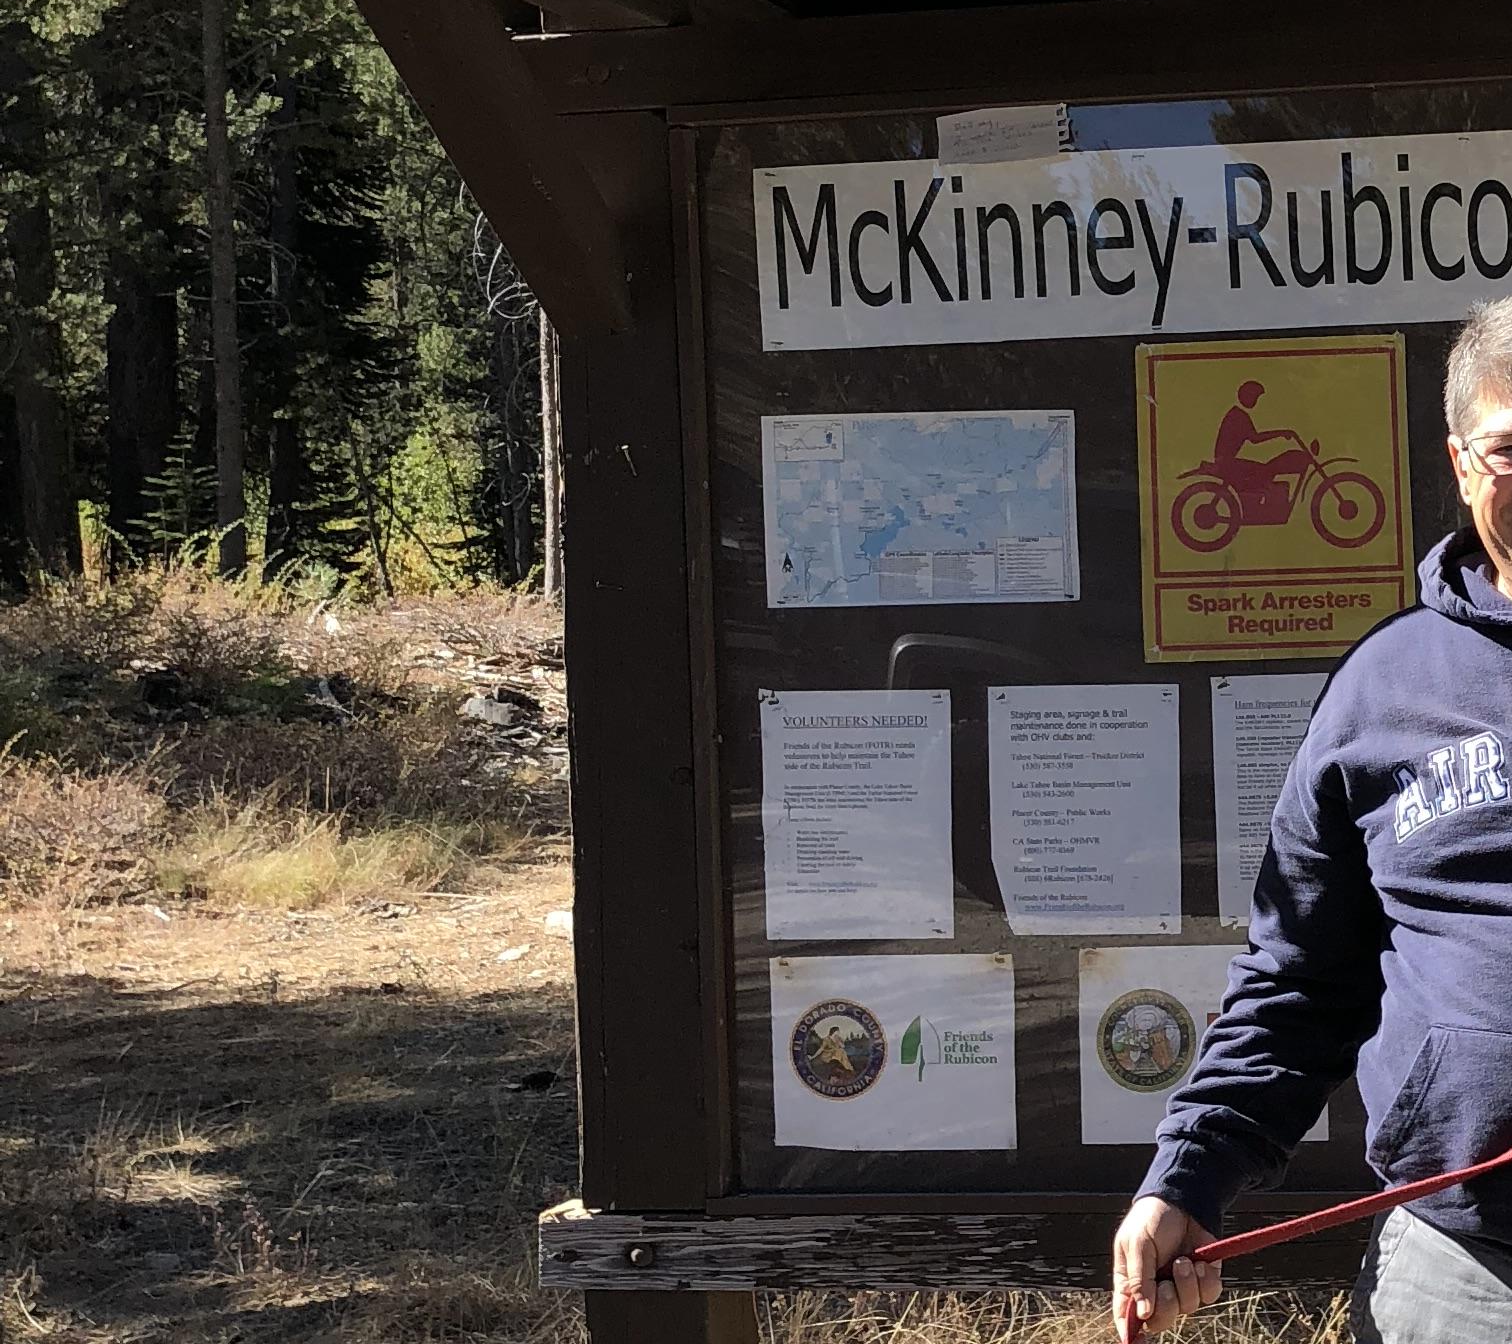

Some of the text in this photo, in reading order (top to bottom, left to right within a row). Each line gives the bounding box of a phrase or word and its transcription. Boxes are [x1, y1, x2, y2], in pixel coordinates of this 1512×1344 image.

[1187, 592, 1371, 616] Spark Arresters
[1227, 613, 1333, 636] Required
[1010, 709, 1128, 720] Staging area, signage & trail
[783, 715, 928, 727] VOLUNTEERS NEEDED!
[1010, 720, 1148, 730] maintenance done in cooperation
[1010, 733, 1095, 742] with OHV clubs and:
[1392, 730, 1510, 844] AIR
[799, 1004, 846, 1033] DORADO
[944, 1031, 993, 1042] Friends
[944, 1042, 980, 1053] of the
[944, 1053, 998, 1064] Rubicon
[806, 1074, 874, 1097] CALIFORNIA
